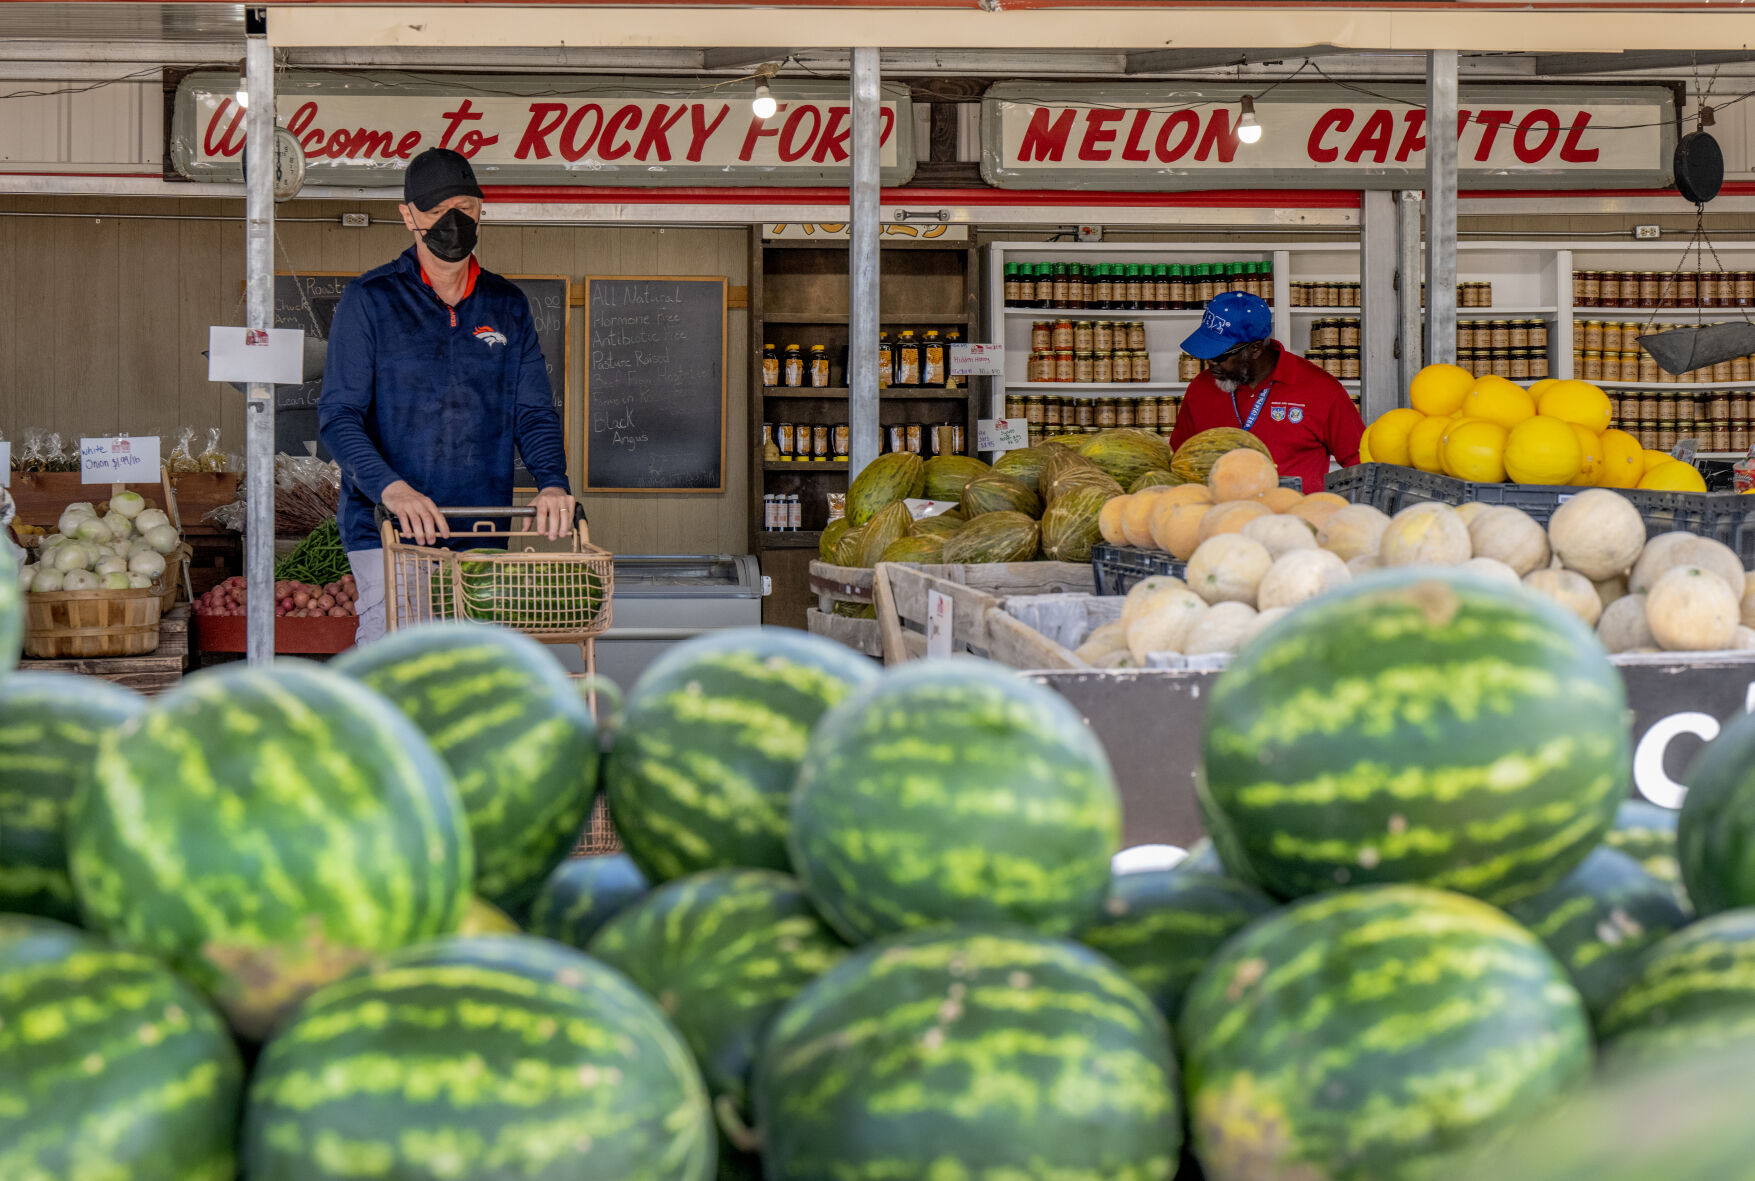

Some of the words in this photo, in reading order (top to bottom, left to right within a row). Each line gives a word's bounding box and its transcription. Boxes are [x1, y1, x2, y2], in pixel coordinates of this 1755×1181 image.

[204, 97, 421, 160] Wlcome
[438, 98, 499, 160] to
[514, 103, 730, 162] ROCKY
[1017, 107, 1243, 163] MELON
[592, 284, 616, 306] All
[624, 284, 682, 305] Natural
[593, 310, 650, 328] Hormone
[592, 327, 660, 348] Antibiotic
[592, 350, 632, 370] Pasture
[593, 405, 635, 433] Black
[612, 431, 649, 452] Angus
